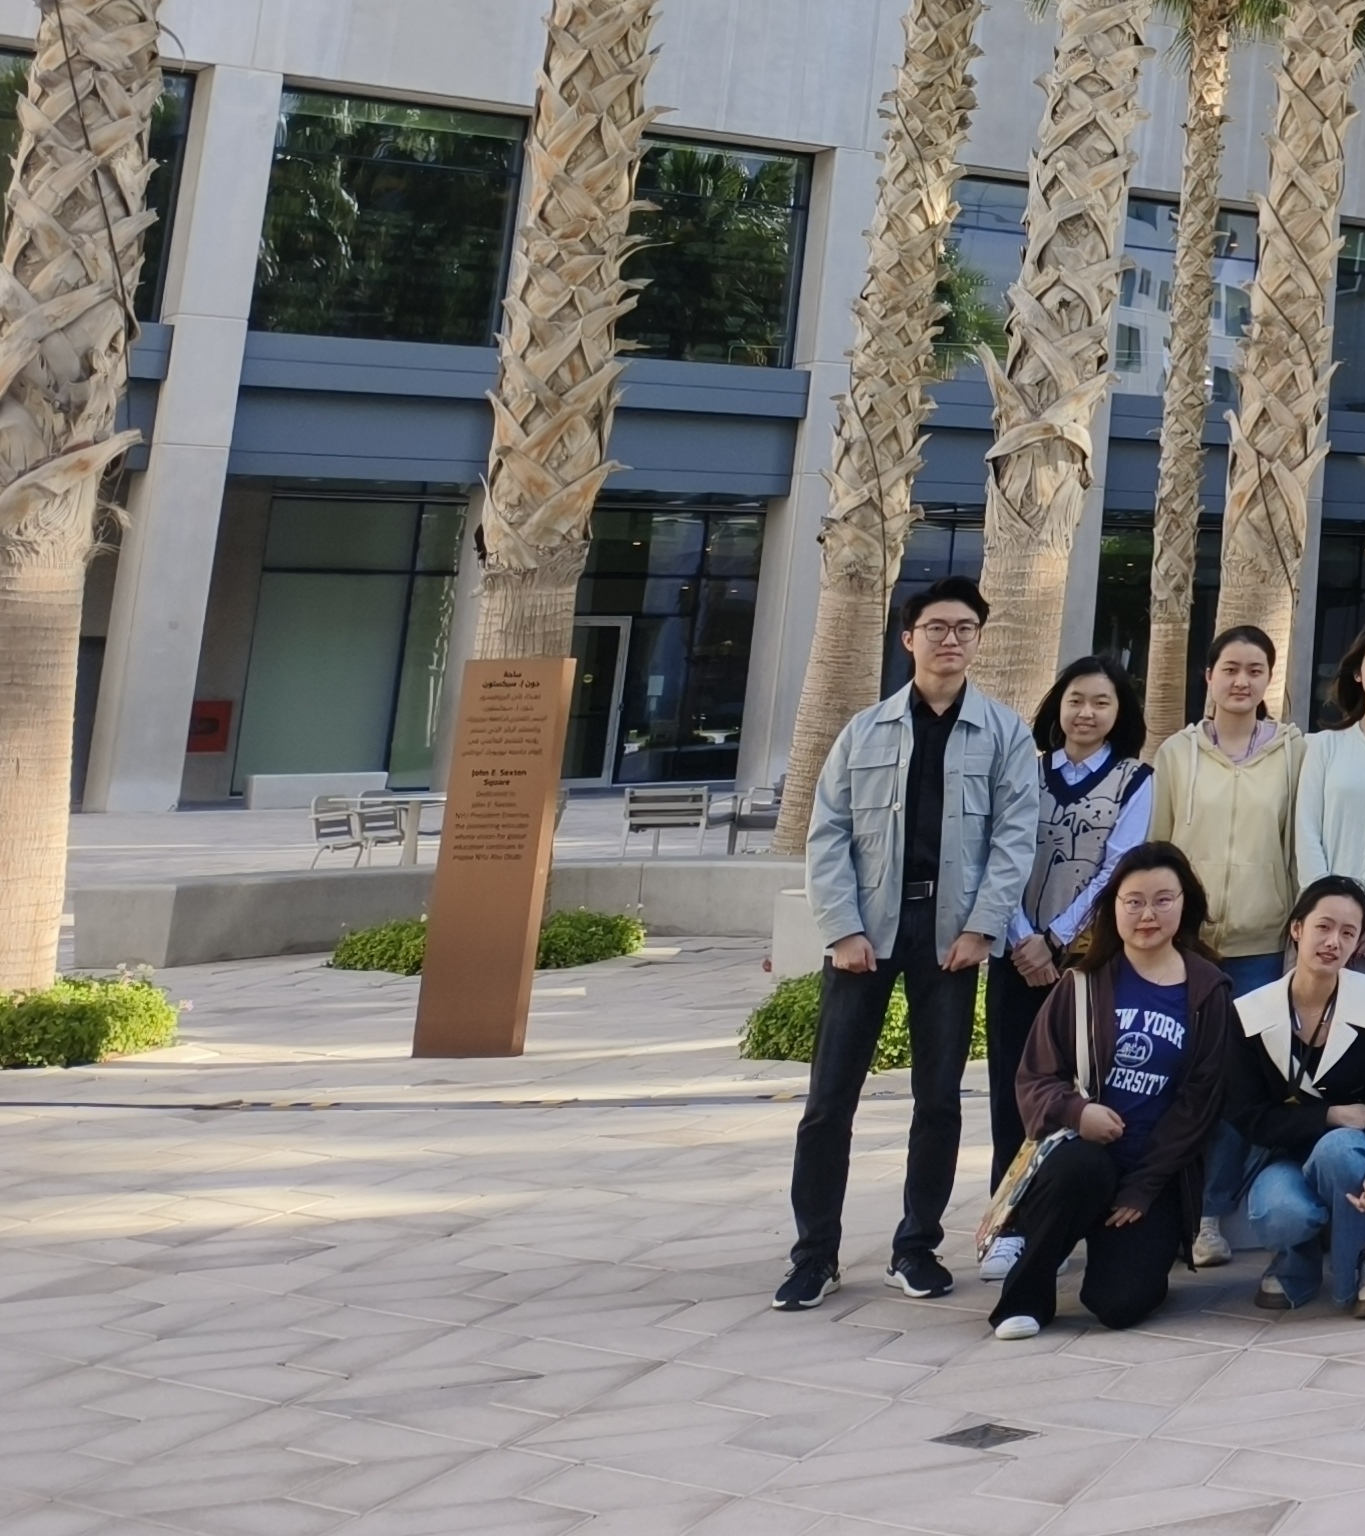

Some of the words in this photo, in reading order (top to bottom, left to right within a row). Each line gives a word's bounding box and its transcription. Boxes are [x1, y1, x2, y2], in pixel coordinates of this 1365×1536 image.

[471, 769, 489, 777] John
[483, 779, 511, 787] Square
[1142, 1010, 1186, 1050] YORK
